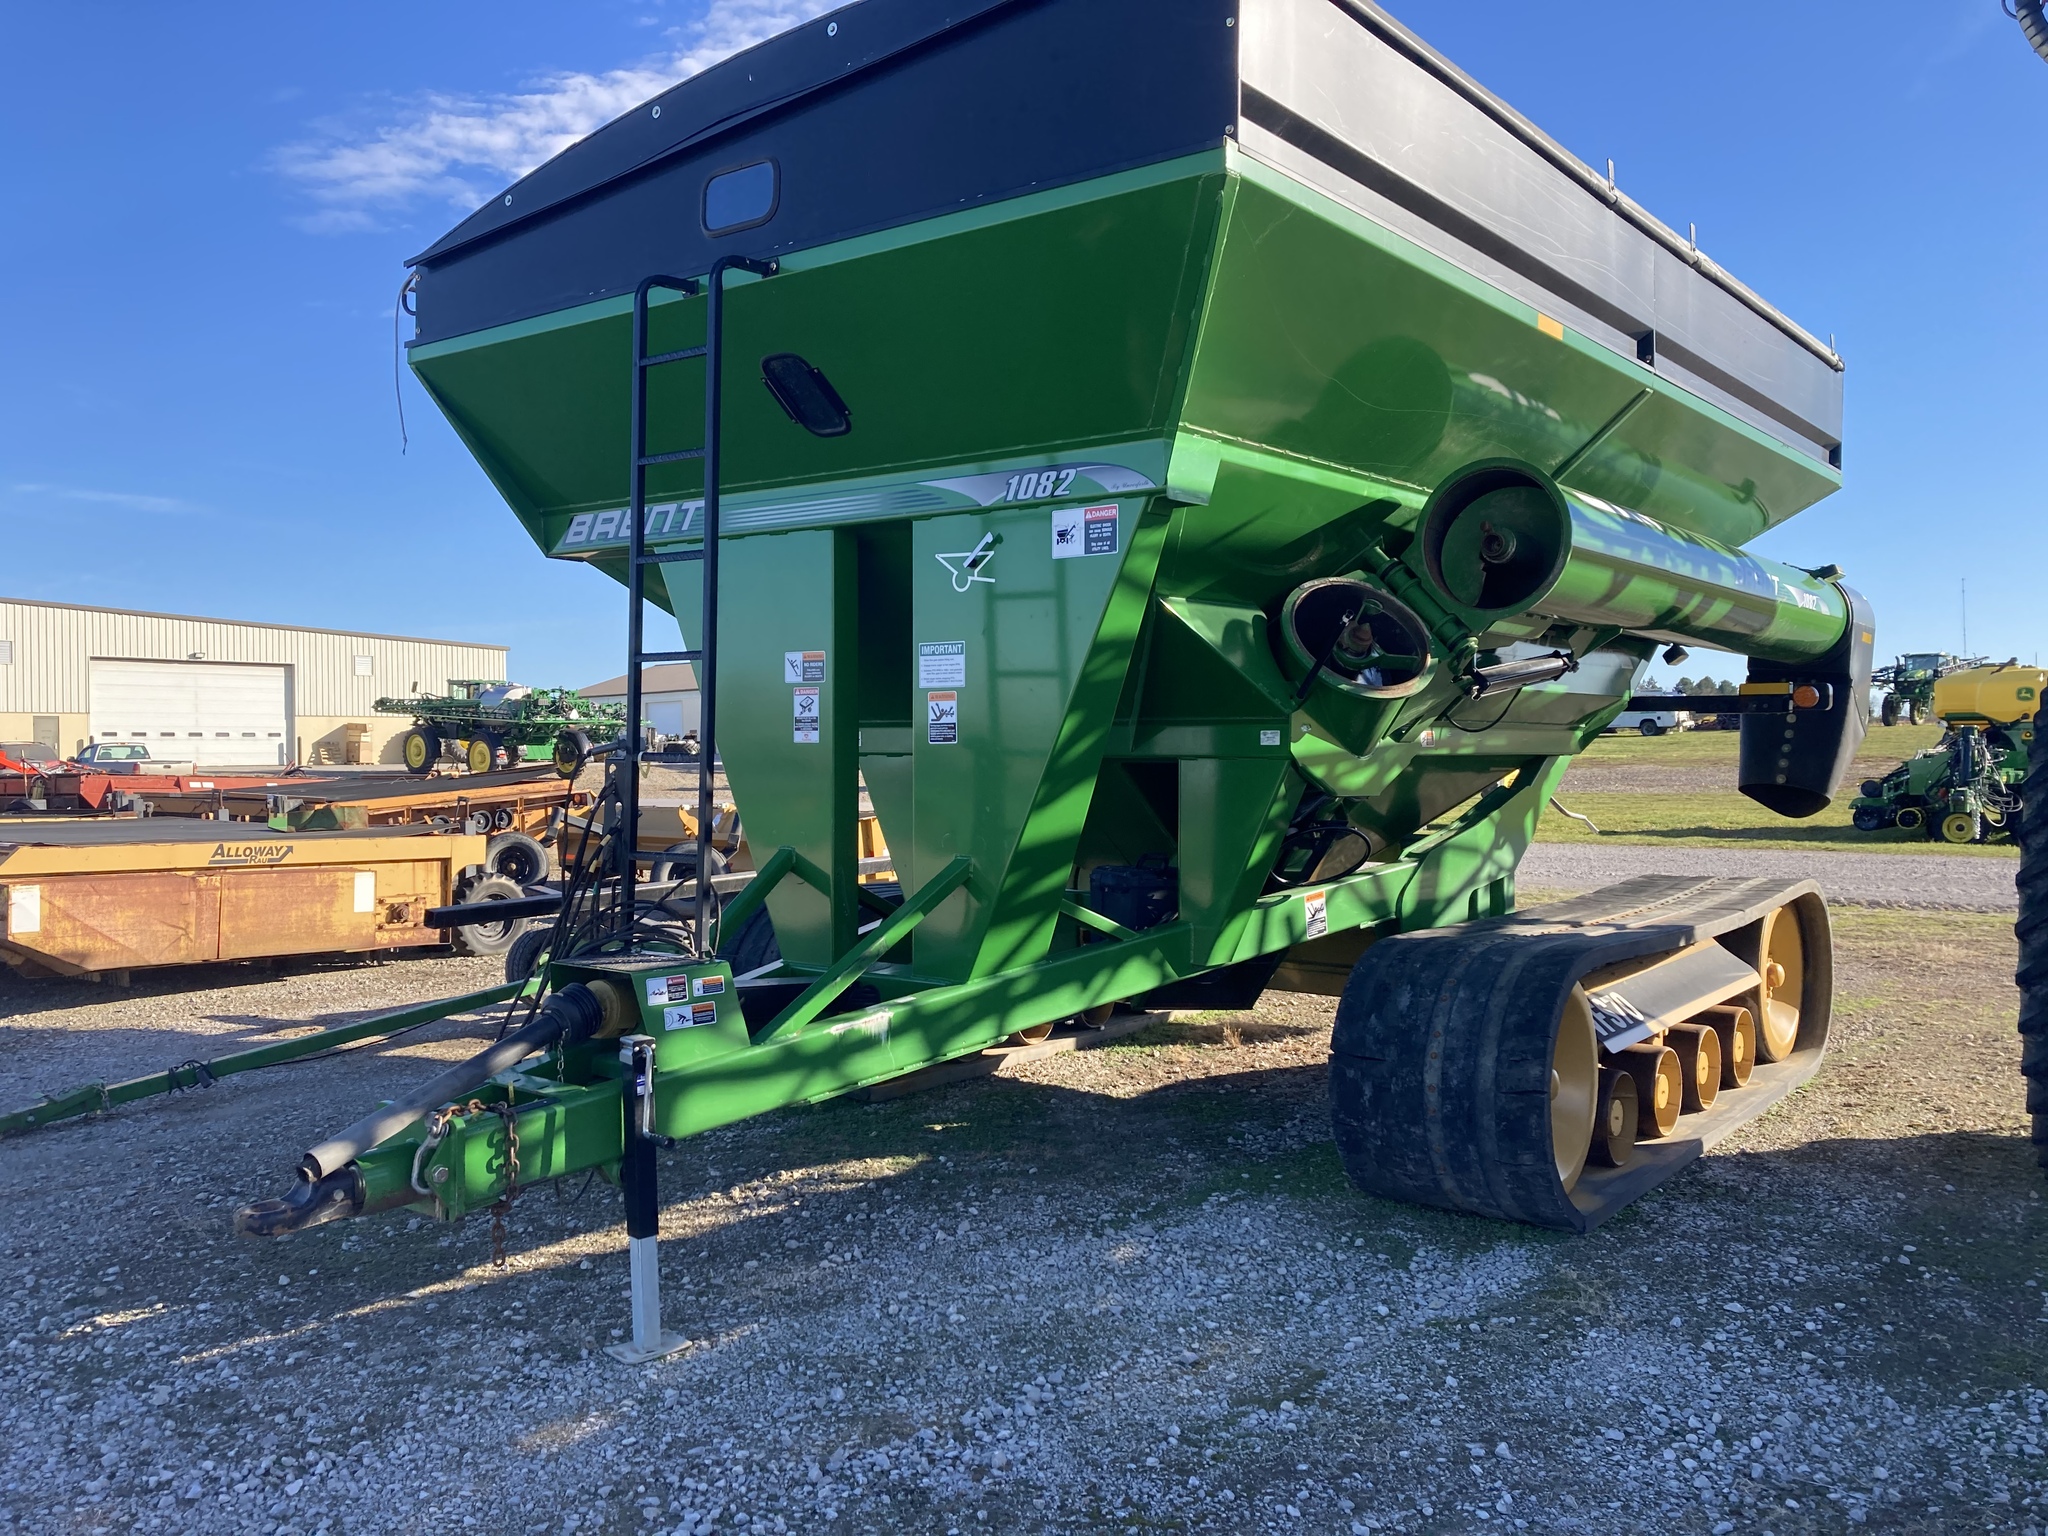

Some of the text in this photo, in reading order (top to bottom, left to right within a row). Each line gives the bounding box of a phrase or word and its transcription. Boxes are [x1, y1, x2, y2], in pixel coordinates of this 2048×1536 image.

[1006, 469, 1077, 500] 1082
[1091, 508, 1117, 518] DANGER
[565, 499, 706, 544] BRENT
[921, 644, 963, 655] IMPORTANT
[211, 843, 284, 858] ALLOWAY
[249, 855, 268, 864] RAU
